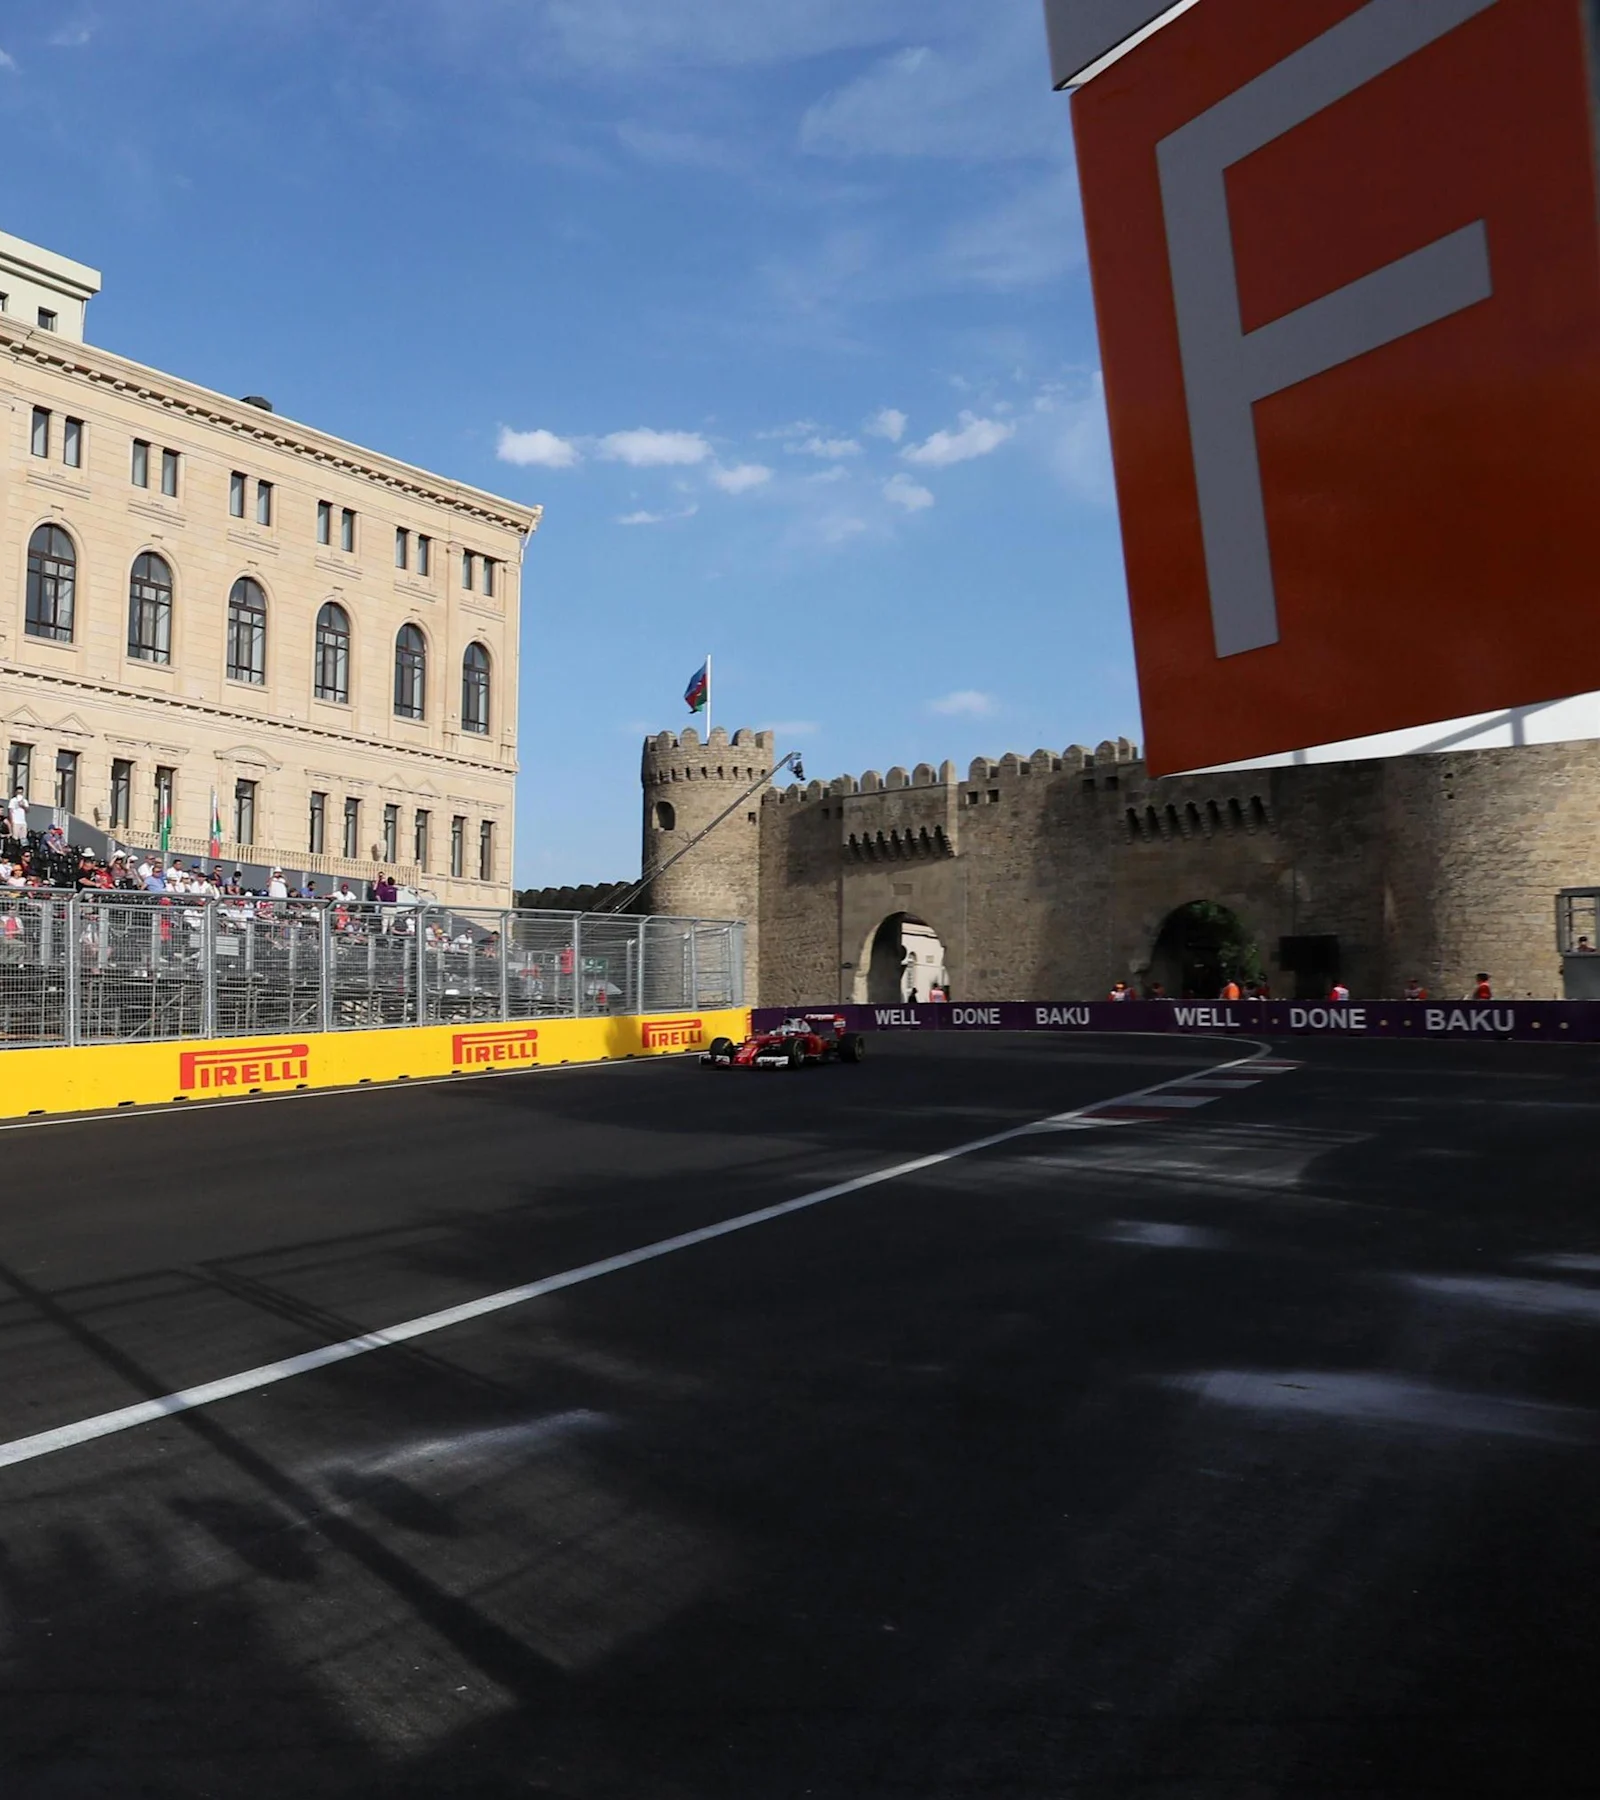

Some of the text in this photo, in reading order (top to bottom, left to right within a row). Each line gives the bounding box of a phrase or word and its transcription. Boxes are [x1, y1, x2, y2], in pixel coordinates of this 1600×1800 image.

[875, 1007, 1090, 1025] WELL DONE BAKU
[1174, 1007, 1516, 1032] WELL DONE BAKU
[452, 1029, 538, 1065] PIRELLI
[641, 1018, 703, 1048] PIRELLI
[180, 1044, 309, 1090] PIRELLI
